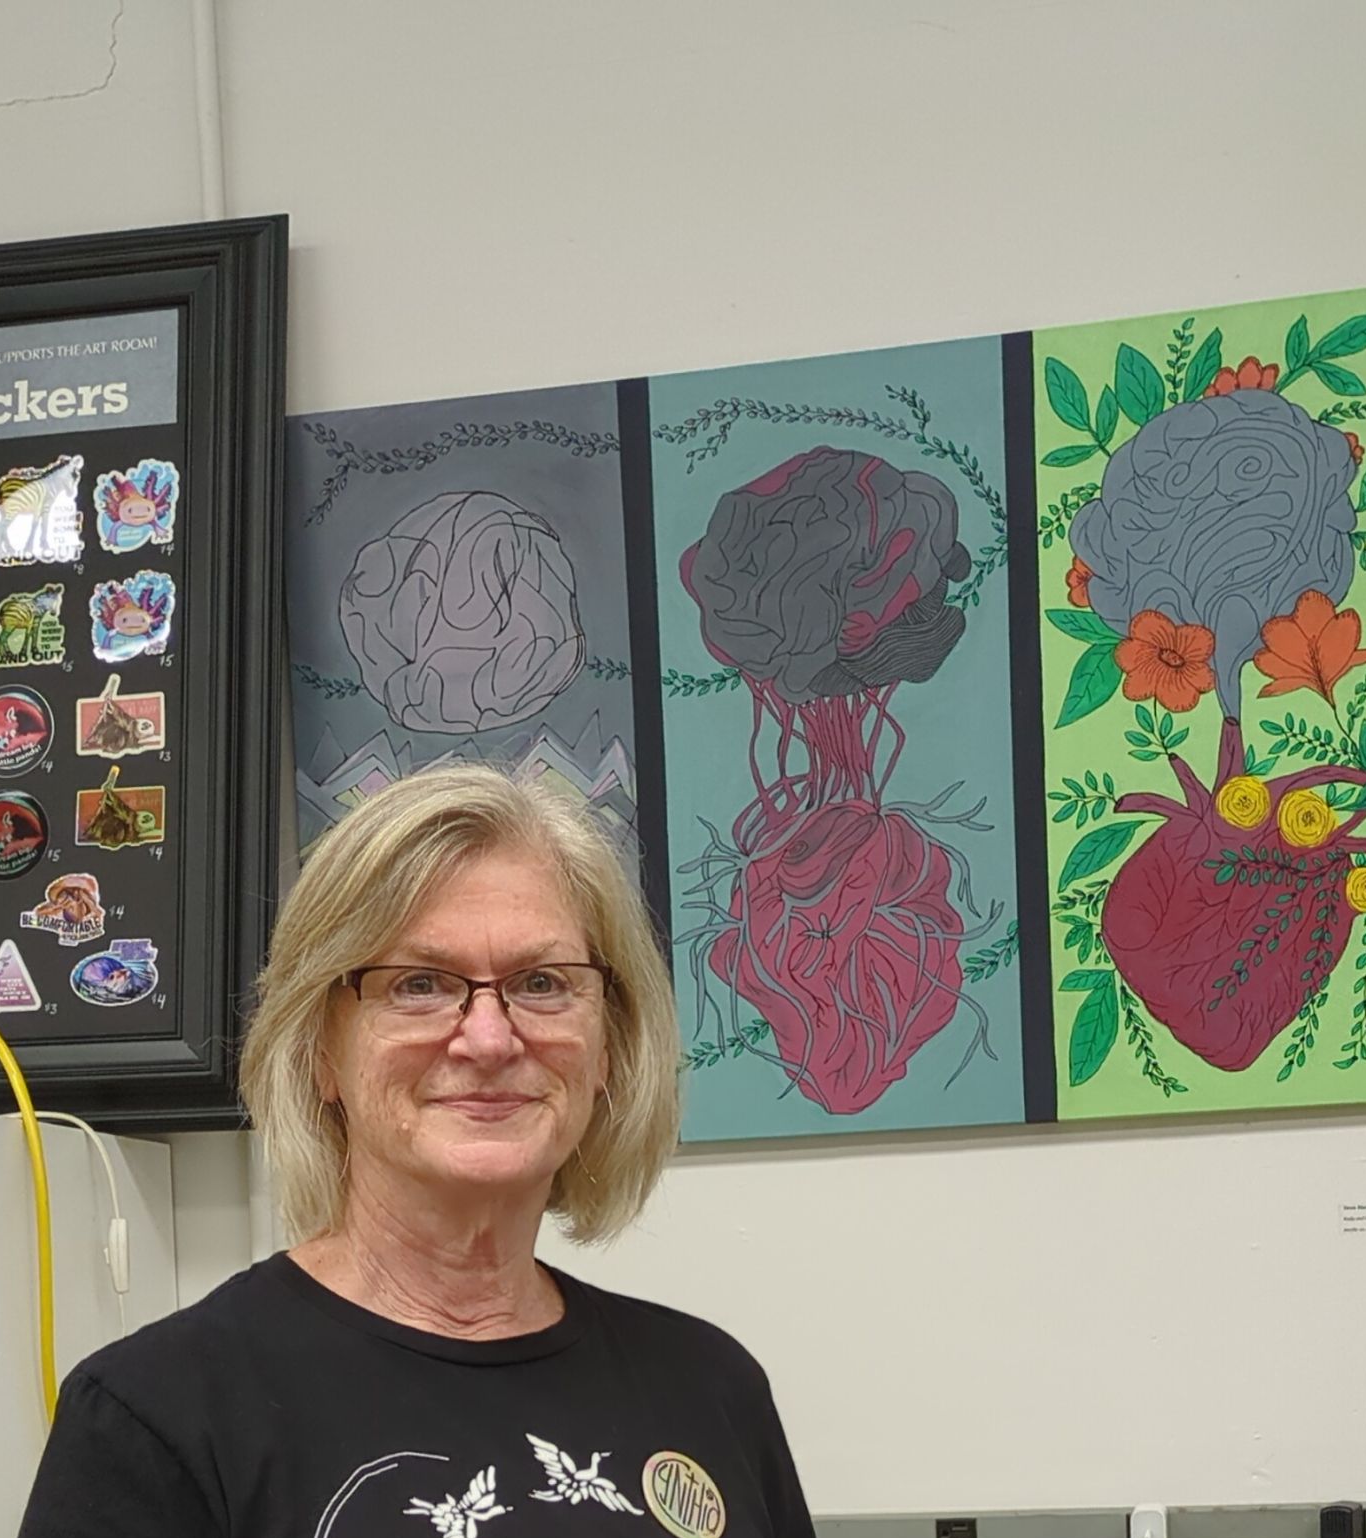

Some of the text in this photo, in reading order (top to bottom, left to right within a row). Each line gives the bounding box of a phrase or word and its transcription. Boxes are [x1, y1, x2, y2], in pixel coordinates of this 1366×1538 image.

[57, 344, 81, 358] THE
[83, 340, 107, 355] ART
[111, 336, 158, 352] ROOM!
[33, 650, 63, 662] OUT
[44, 1003, 58, 1014] $3
